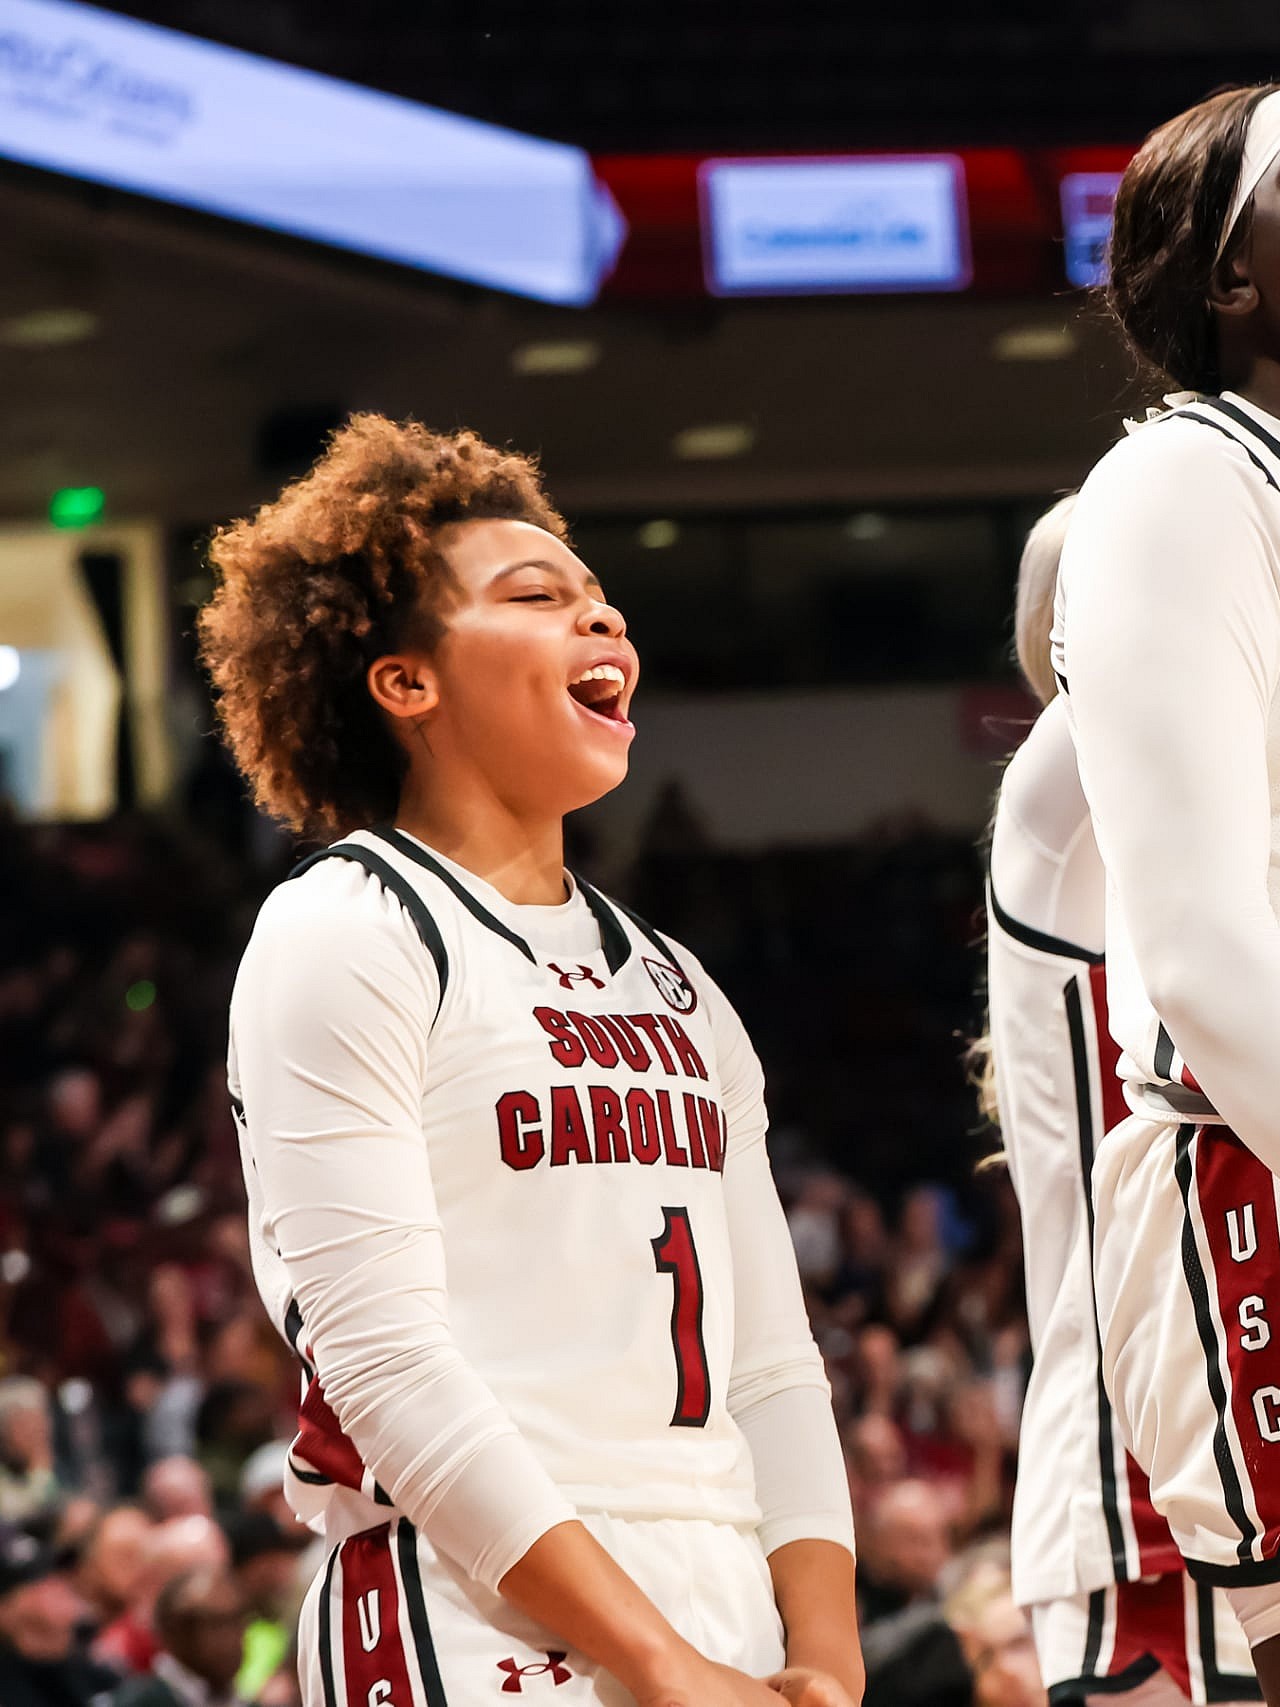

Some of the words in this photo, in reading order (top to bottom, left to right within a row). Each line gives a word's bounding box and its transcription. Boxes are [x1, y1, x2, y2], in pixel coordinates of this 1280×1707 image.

[532, 1006, 709, 1081] SOUTH
[495, 1085, 727, 1177] CAROLIN
[650, 1206, 711, 1428] 1
